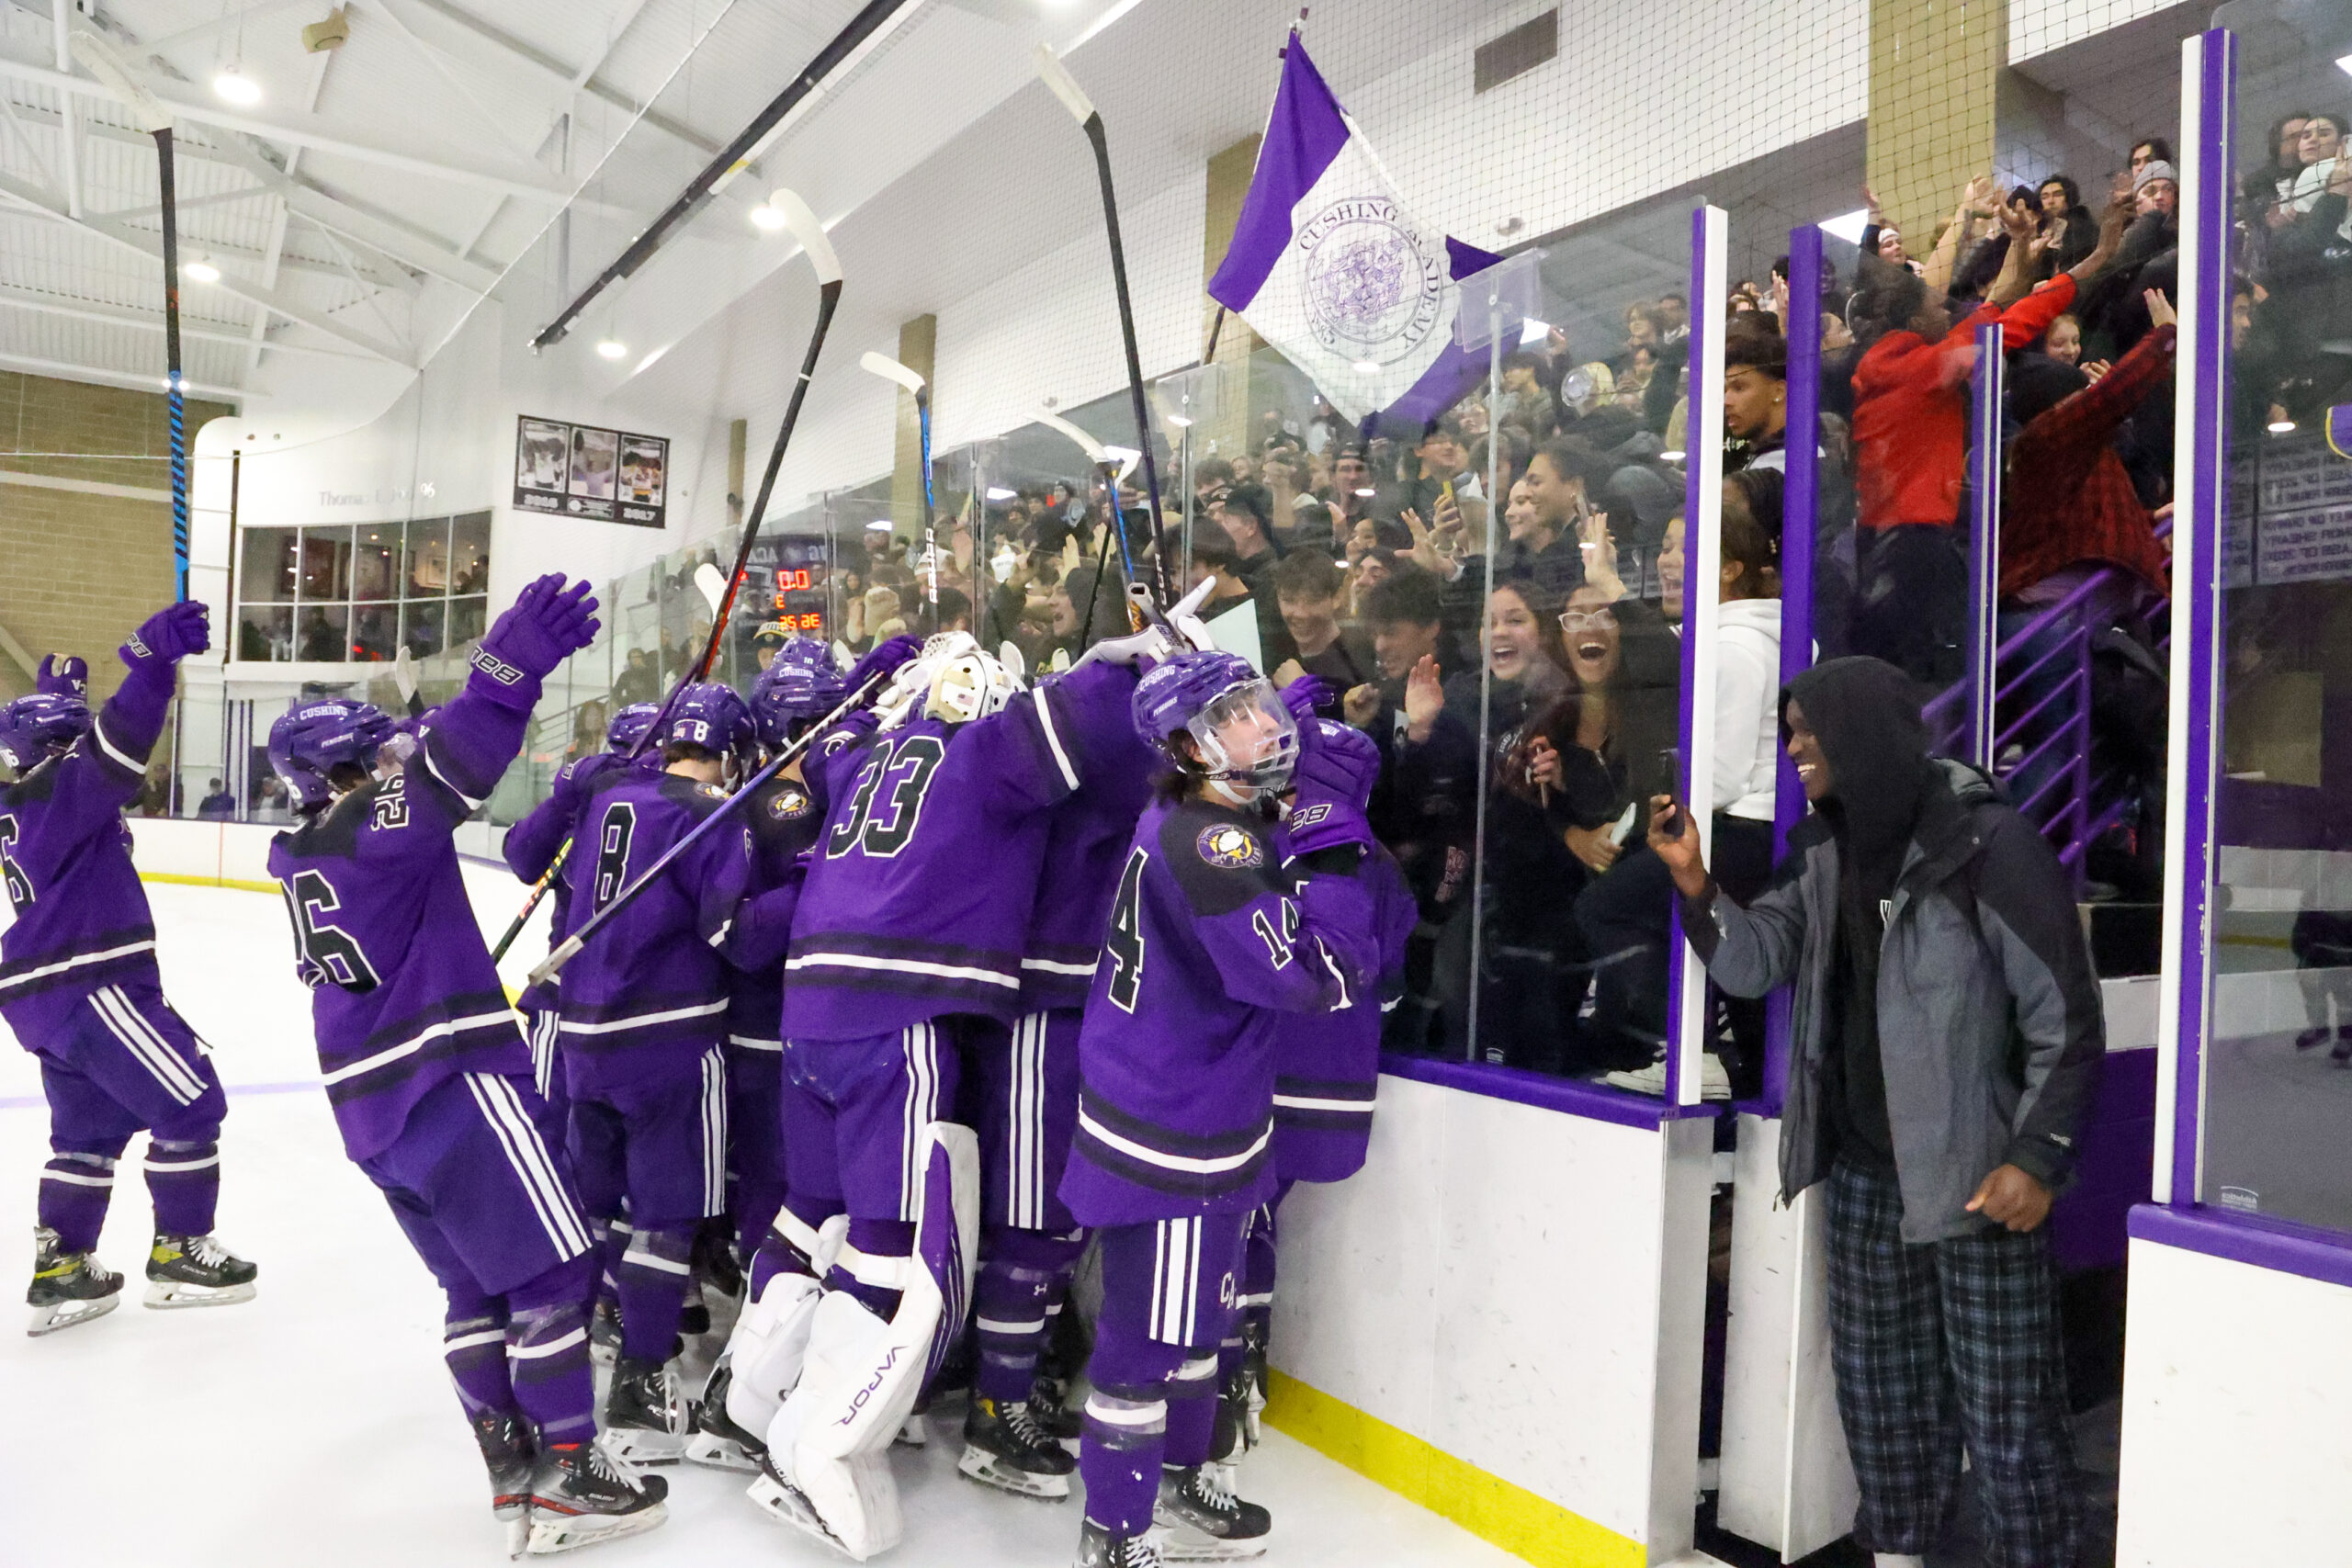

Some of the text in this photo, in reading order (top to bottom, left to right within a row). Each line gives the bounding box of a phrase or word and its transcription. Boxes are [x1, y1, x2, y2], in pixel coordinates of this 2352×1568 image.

[1300, 203, 1440, 348] CUSHING AADEMY
[779, 668, 815, 678] CUSHING
[1139, 664, 1176, 691] CUSHING
[300, 705, 348, 721] CUSHING
[694, 720, 707, 742] 8
[826, 735, 945, 860] 33
[593, 802, 637, 917] 8
[831, 1346, 910, 1426] VAPOR
